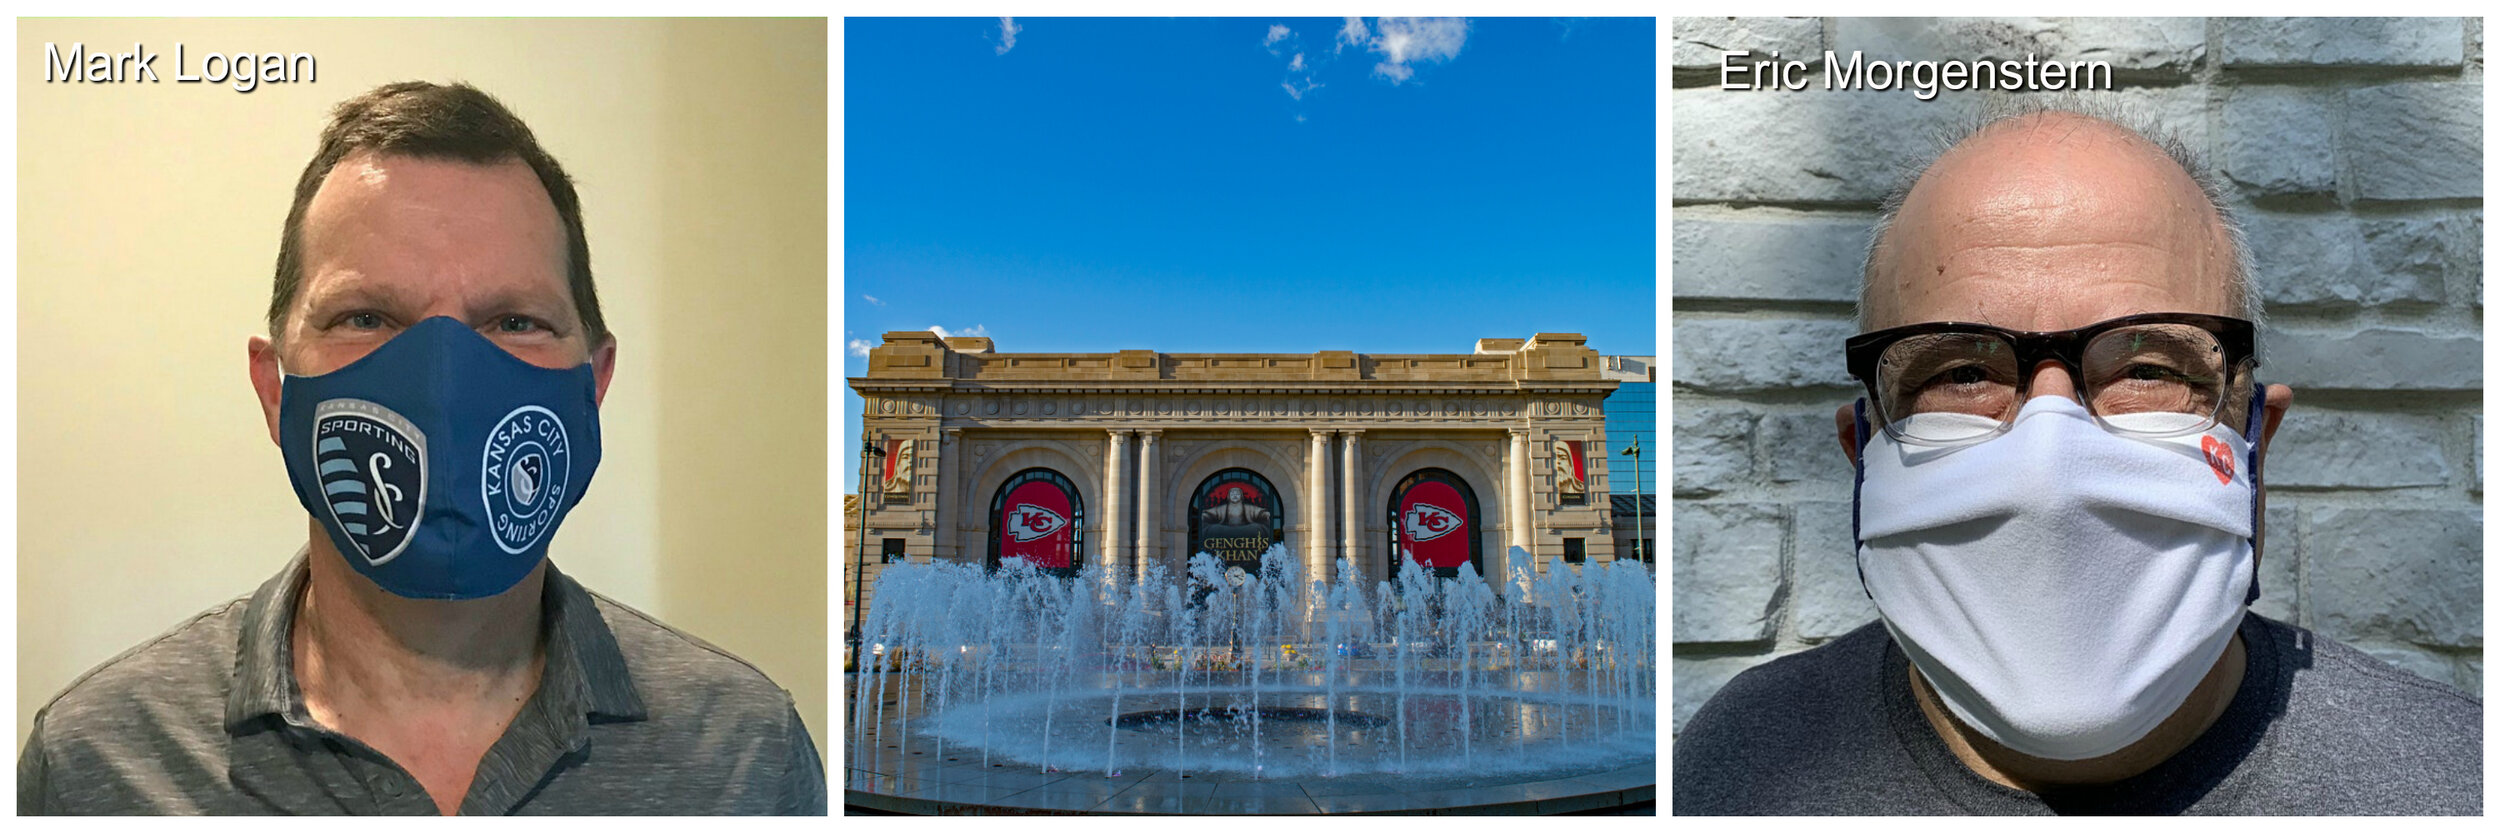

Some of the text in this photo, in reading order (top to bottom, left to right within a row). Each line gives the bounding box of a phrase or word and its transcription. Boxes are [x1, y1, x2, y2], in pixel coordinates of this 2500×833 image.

[320, 420, 416, 465] SPORTING
[487, 415, 564, 496] KANSAS CITY
[2209, 444, 2231, 476] KC
[497, 484, 561, 542] SPORTING
[1021, 512, 1053, 532] KC
[1418, 511, 1449, 532] KC
[1203, 531, 1269, 552] GENGHIS
[1216, 549, 1259, 561] KHAN
